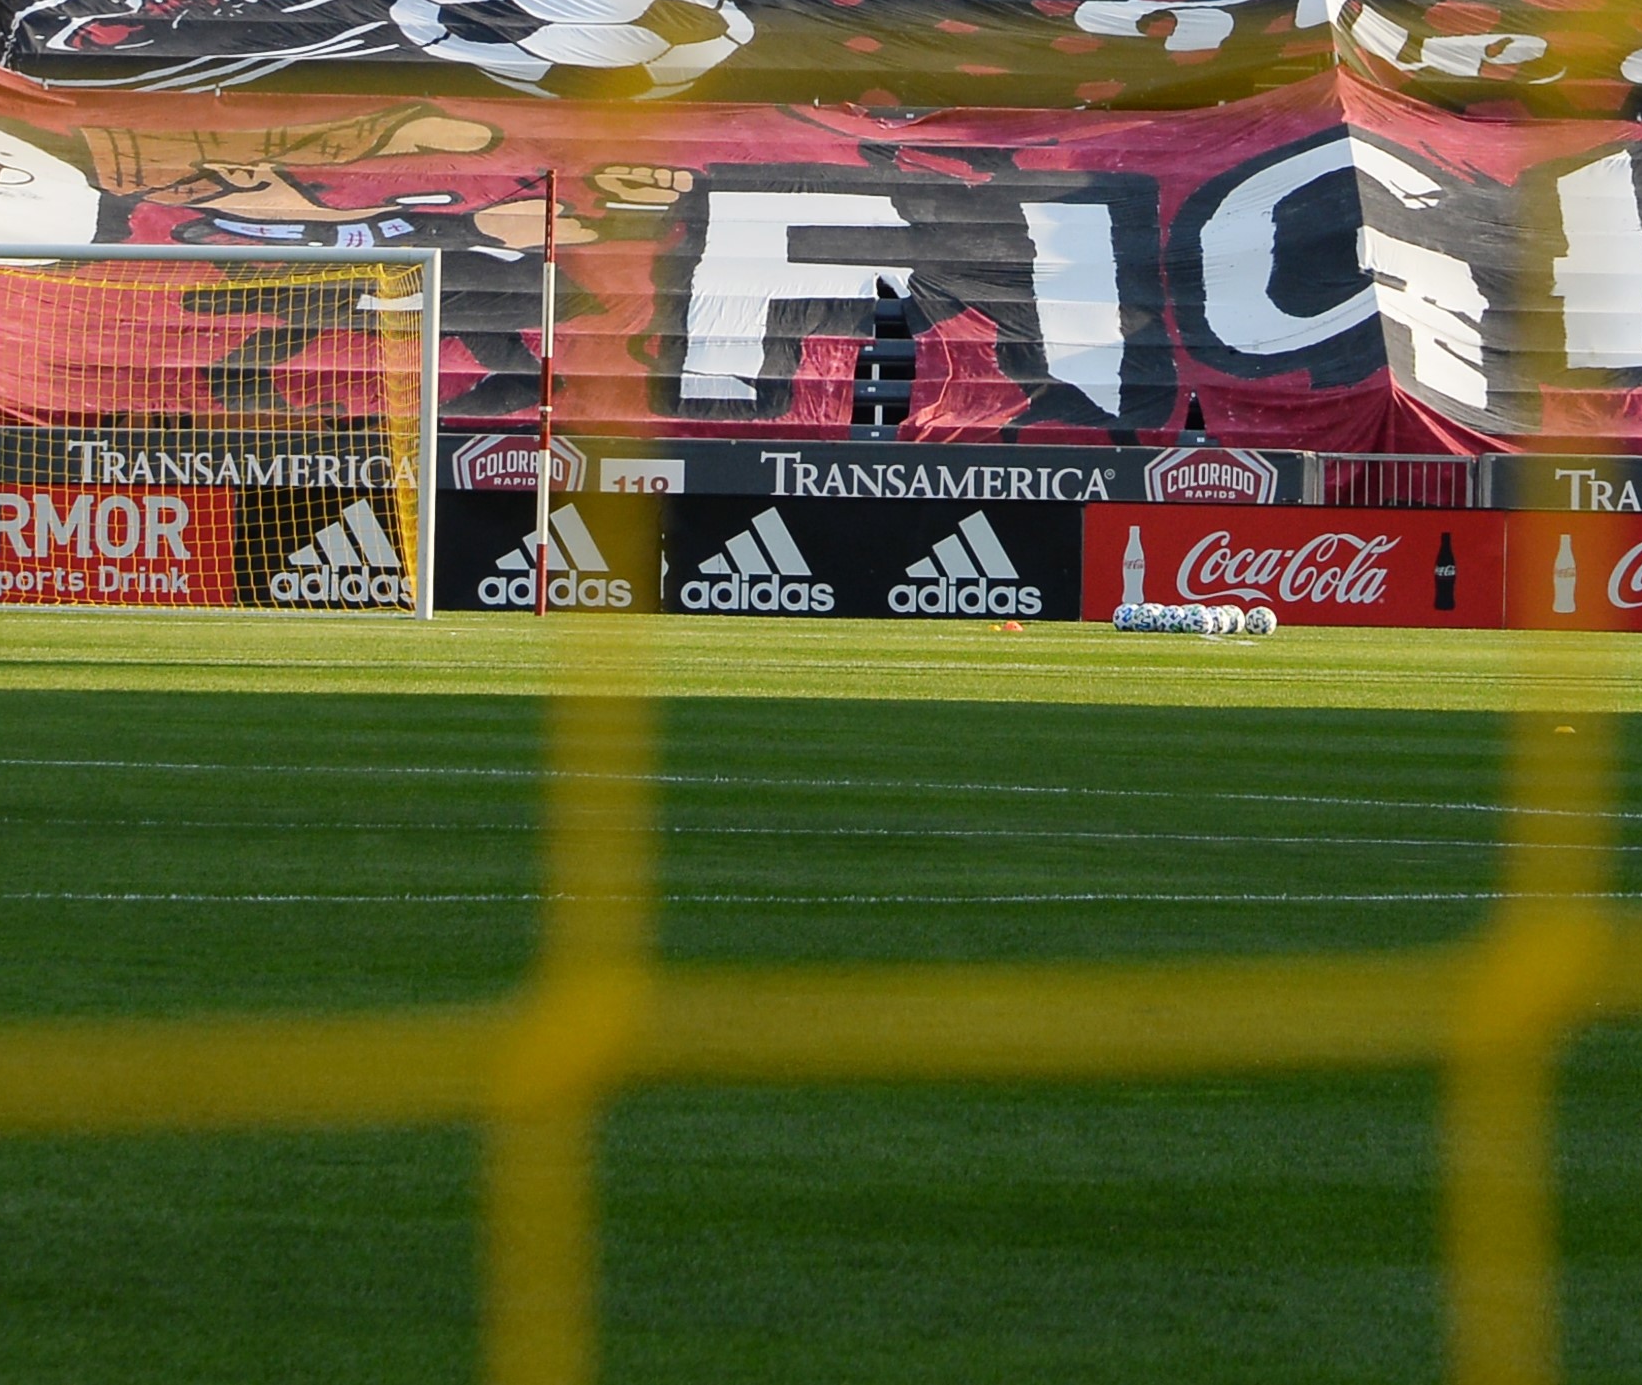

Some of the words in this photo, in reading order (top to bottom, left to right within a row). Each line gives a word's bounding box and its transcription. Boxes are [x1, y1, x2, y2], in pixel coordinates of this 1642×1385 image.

[475, 450, 564, 482] COLORAO
[493, 477, 539, 486] RAPID
[1166, 461, 1255, 495] COLORADO
[1184, 488, 1237, 499] RAPIDS
[97, 565, 190, 594] Drink
[270, 564, 415, 603] adidas
[1175, 529, 1403, 604] Coca-Cola
[477, 570, 632, 608] addas
[680, 573, 835, 613] adidas
[887, 576, 1043, 616] adidas
